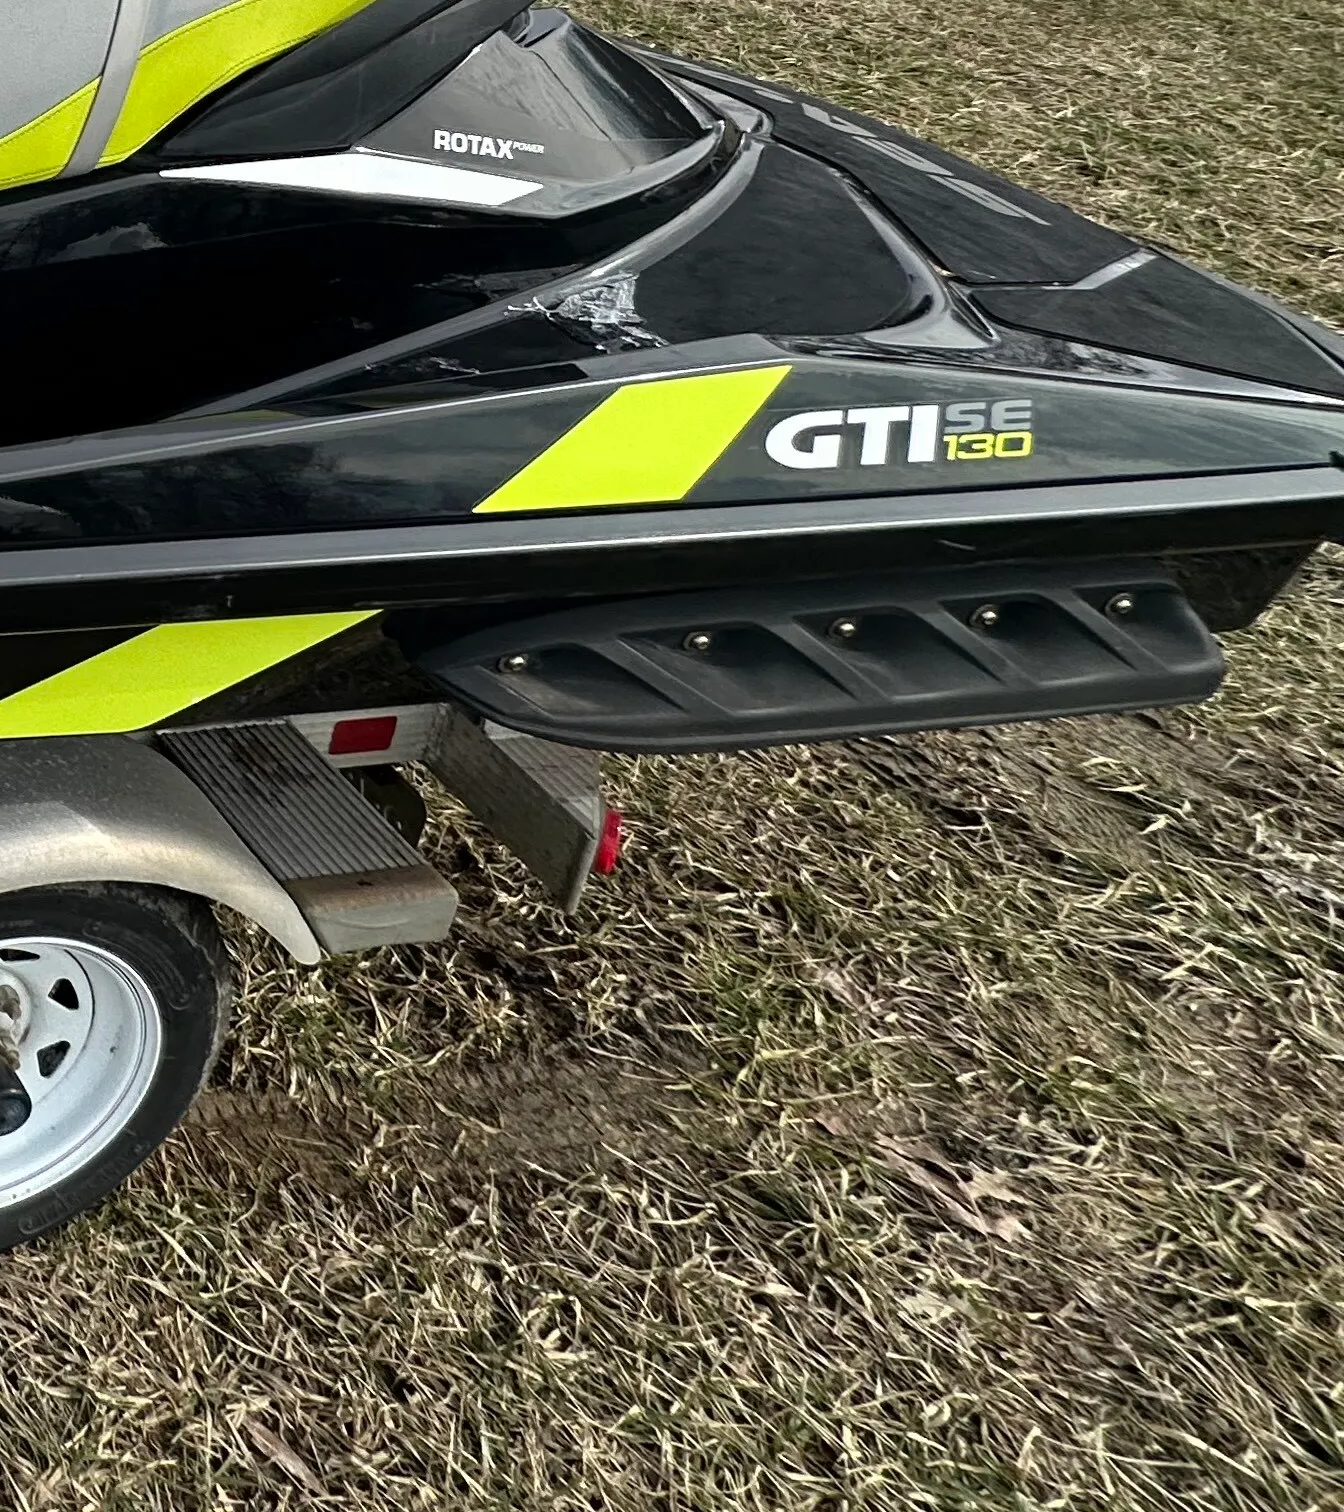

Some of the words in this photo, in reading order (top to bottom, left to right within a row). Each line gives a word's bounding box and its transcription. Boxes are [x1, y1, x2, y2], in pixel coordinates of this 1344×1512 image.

[433, 129, 513, 160] ROTAX
[765, 404, 939, 469] GTI
[944, 400, 1032, 434] SE
[943, 431, 1033, 461] 130
